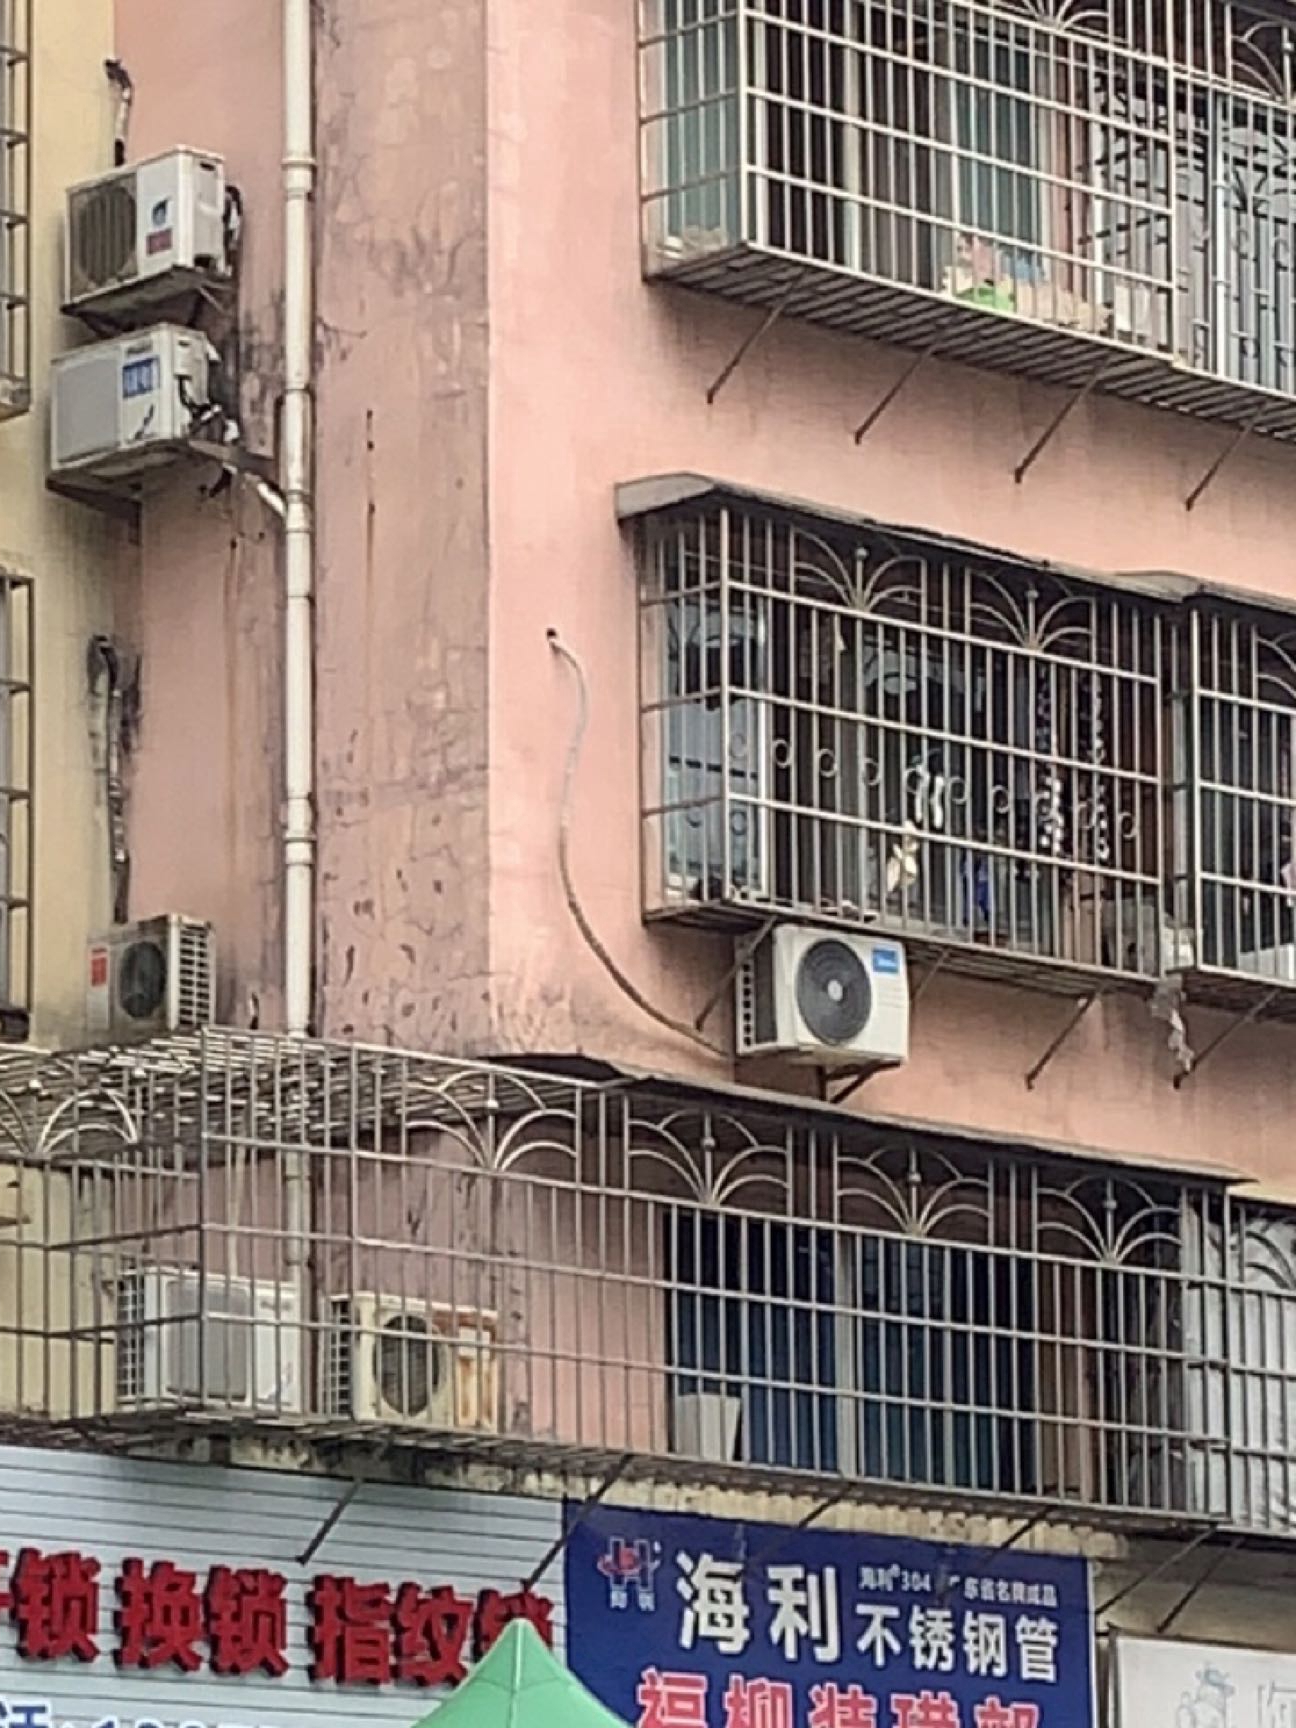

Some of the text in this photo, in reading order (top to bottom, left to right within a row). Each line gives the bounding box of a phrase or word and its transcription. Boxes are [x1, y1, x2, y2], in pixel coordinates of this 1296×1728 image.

[114, 1556, 290, 1676] 换锁
[675, 1549, 840, 1664] 海利
[855, 1603, 1059, 1683] 不锈钢管
